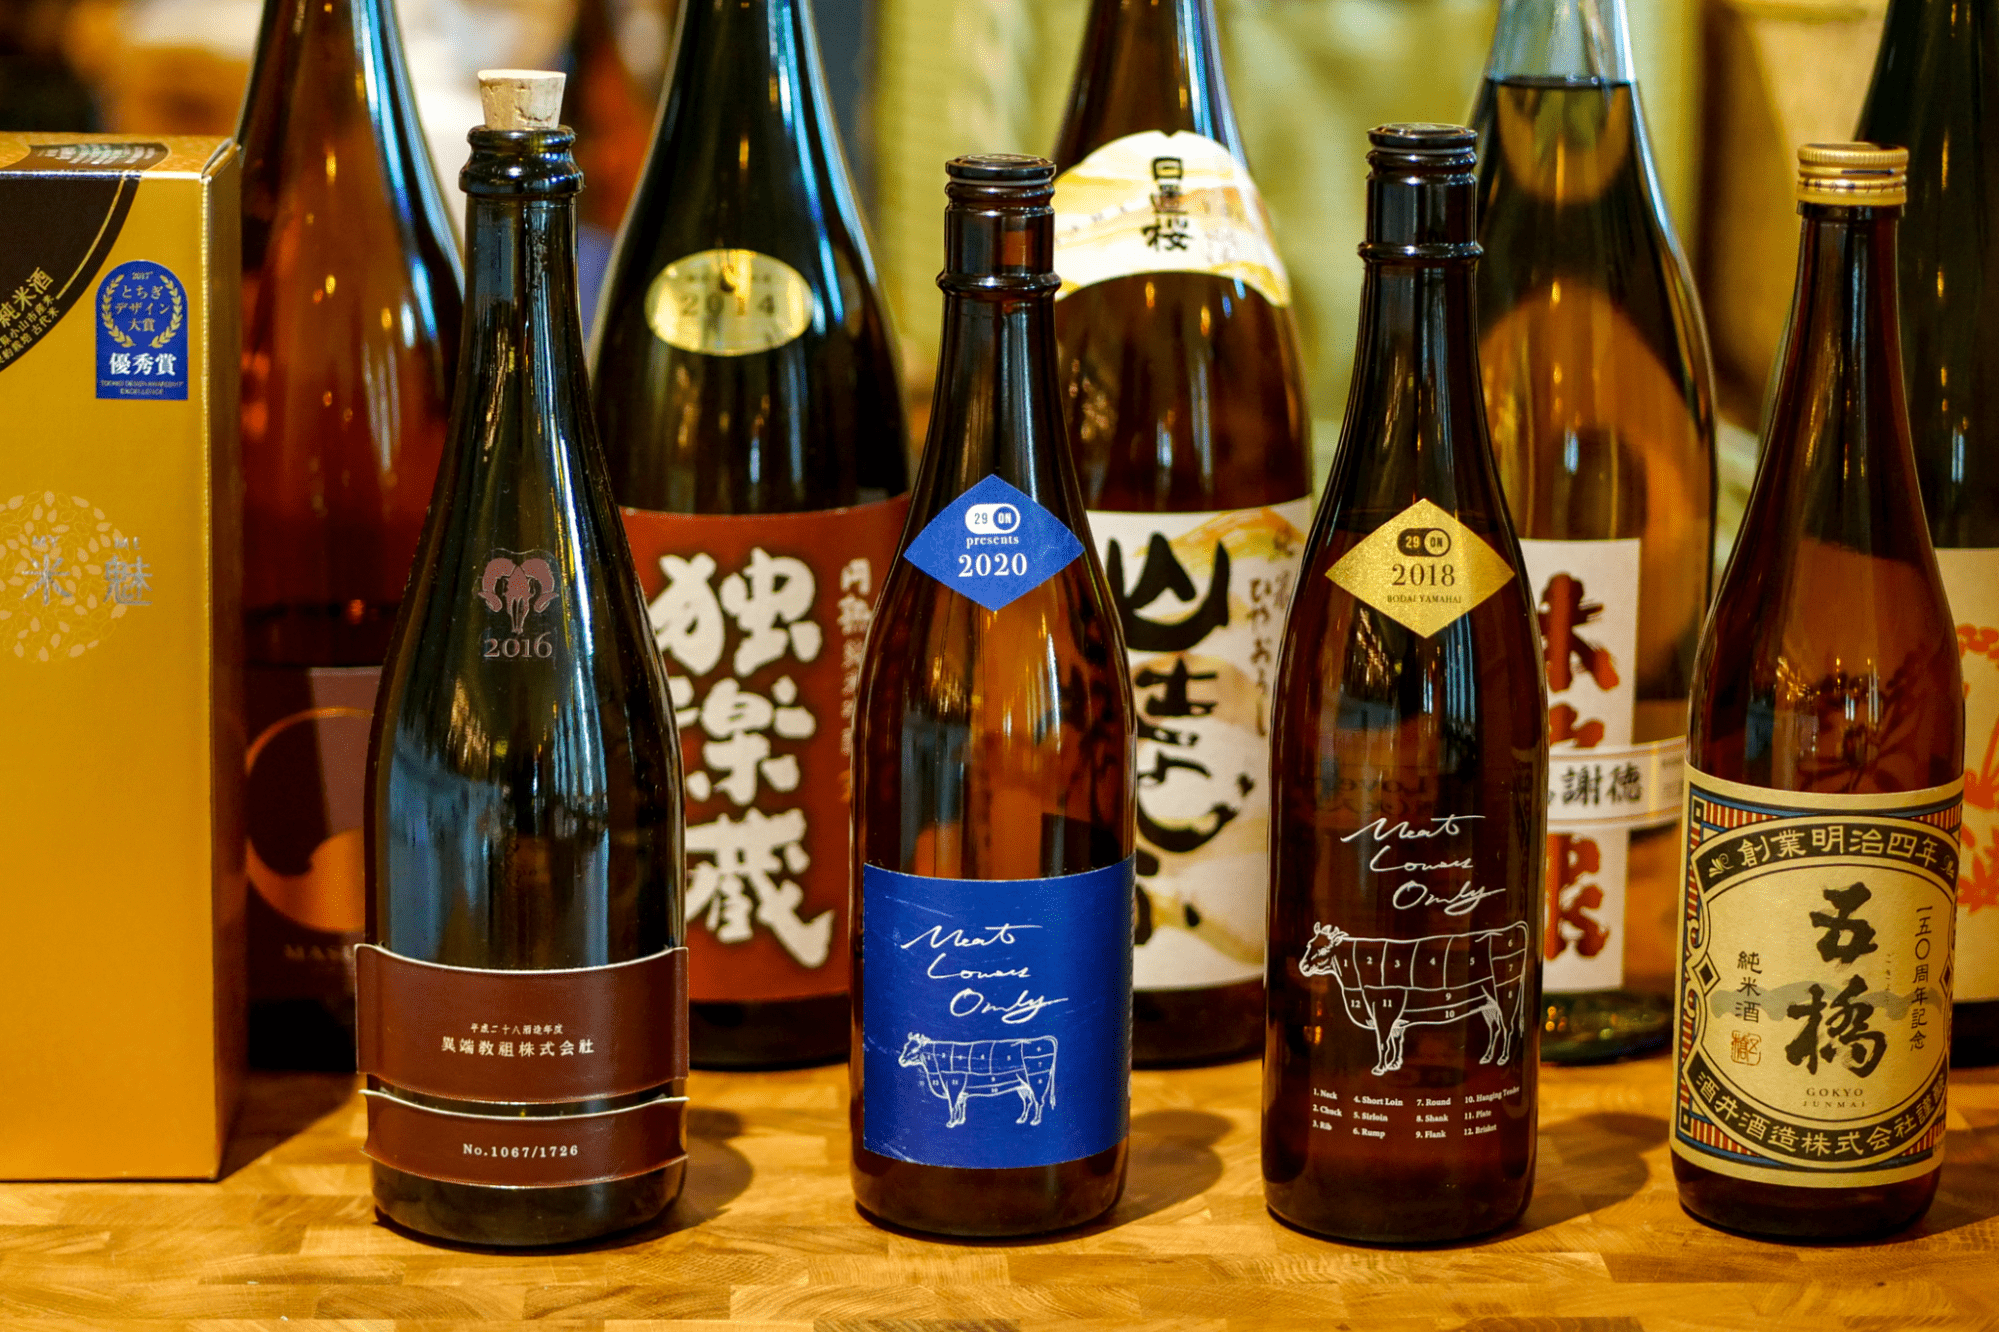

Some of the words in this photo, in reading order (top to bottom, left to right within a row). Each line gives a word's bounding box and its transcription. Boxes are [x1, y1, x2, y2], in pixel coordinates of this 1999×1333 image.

[1142, 156, 1193, 252] 日置桜
[0, 266, 54, 329] 純米酒
[122, 285, 163, 300] とちぎ
[114, 302, 170, 316] デザイン
[127, 318, 157, 332] 大賞
[109, 352, 178, 376] 優秀賞
[974, 512, 989, 525] 29
[998, 512, 1013, 524] ON
[965, 535, 1020, 550] presents
[1404, 535, 1421, 548] 29
[1430, 536, 1444, 548] ON
[957, 552, 1029, 578] 2020
[1391, 563, 1456, 587] 2018
[1386, 595, 1416, 603] BODAI
[1419, 595, 1462, 604] YAMAHAI
[484, 632, 554, 659] 2016
[1246, 577, 1271, 738] ひやおろし
[1549, 763, 1642, 806] 謝徳
[1340, 815, 1486, 842] Meat
[1736, 825, 1938, 869] 創業明治四年
[1392, 880, 1506, 916] Only
[900, 923, 1043, 949] Meat
[1344, 959, 1348, 968] 1
[1366, 956, 1373, 965] 2
[1394, 960, 1400, 968] 3
[1428, 957, 1436, 966] 4
[1470, 956, 1475, 966] 5
[1784, 881, 1888, 1079] 五橋
[1909, 904, 1935, 1052] 一五〇周年記念
[1735, 950, 1763, 1024] 純米酒
[1445, 992, 1452, 1001] 9
[950, 987, 1069, 1025] Only
[1350, 999, 1361, 1008] 12
[1382, 999, 1392, 1008] 11
[1444, 1010, 1455, 1018] 10
[470, 1023, 564, 1036] 平成二十八酒造年度
[441, 1036, 595, 1058] 異端教祖株式会社
[1320, 1089, 1338, 1100] Neck
[1464, 1095, 1475, 1104] 10.
[1476, 1091, 1502, 1102] Hanging
[1806, 1087, 1864, 1098] GOKYO
[1353, 1095, 1361, 1103] 4.
[1362, 1096, 1384, 1105] Short
[1384, 1098, 1404, 1106] Loin
[1416, 1098, 1424, 1106] 7.
[1425, 1097, 1452, 1106] Round
[1803, 1100, 1866, 1108] JUNMAI
[1312, 1104, 1319, 1112] 2.
[1320, 1106, 1342, 1117] Chuck
[1353, 1111, 1360, 1120] 5.
[1362, 1112, 1388, 1122] Sirloin
[1464, 1112, 1474, 1120] 11.
[1416, 1114, 1424, 1122] 8.
[1424, 1114, 1449, 1122] Shank
[1352, 1127, 1360, 1136] 6.
[1362, 1128, 1386, 1140] Rump
[1416, 1130, 1424, 1138] 9.
[1424, 1130, 1446, 1138] Flank
[1464, 1128, 1474, 1136] 12.
[463, 1142, 579, 1159] No.1067/1726
